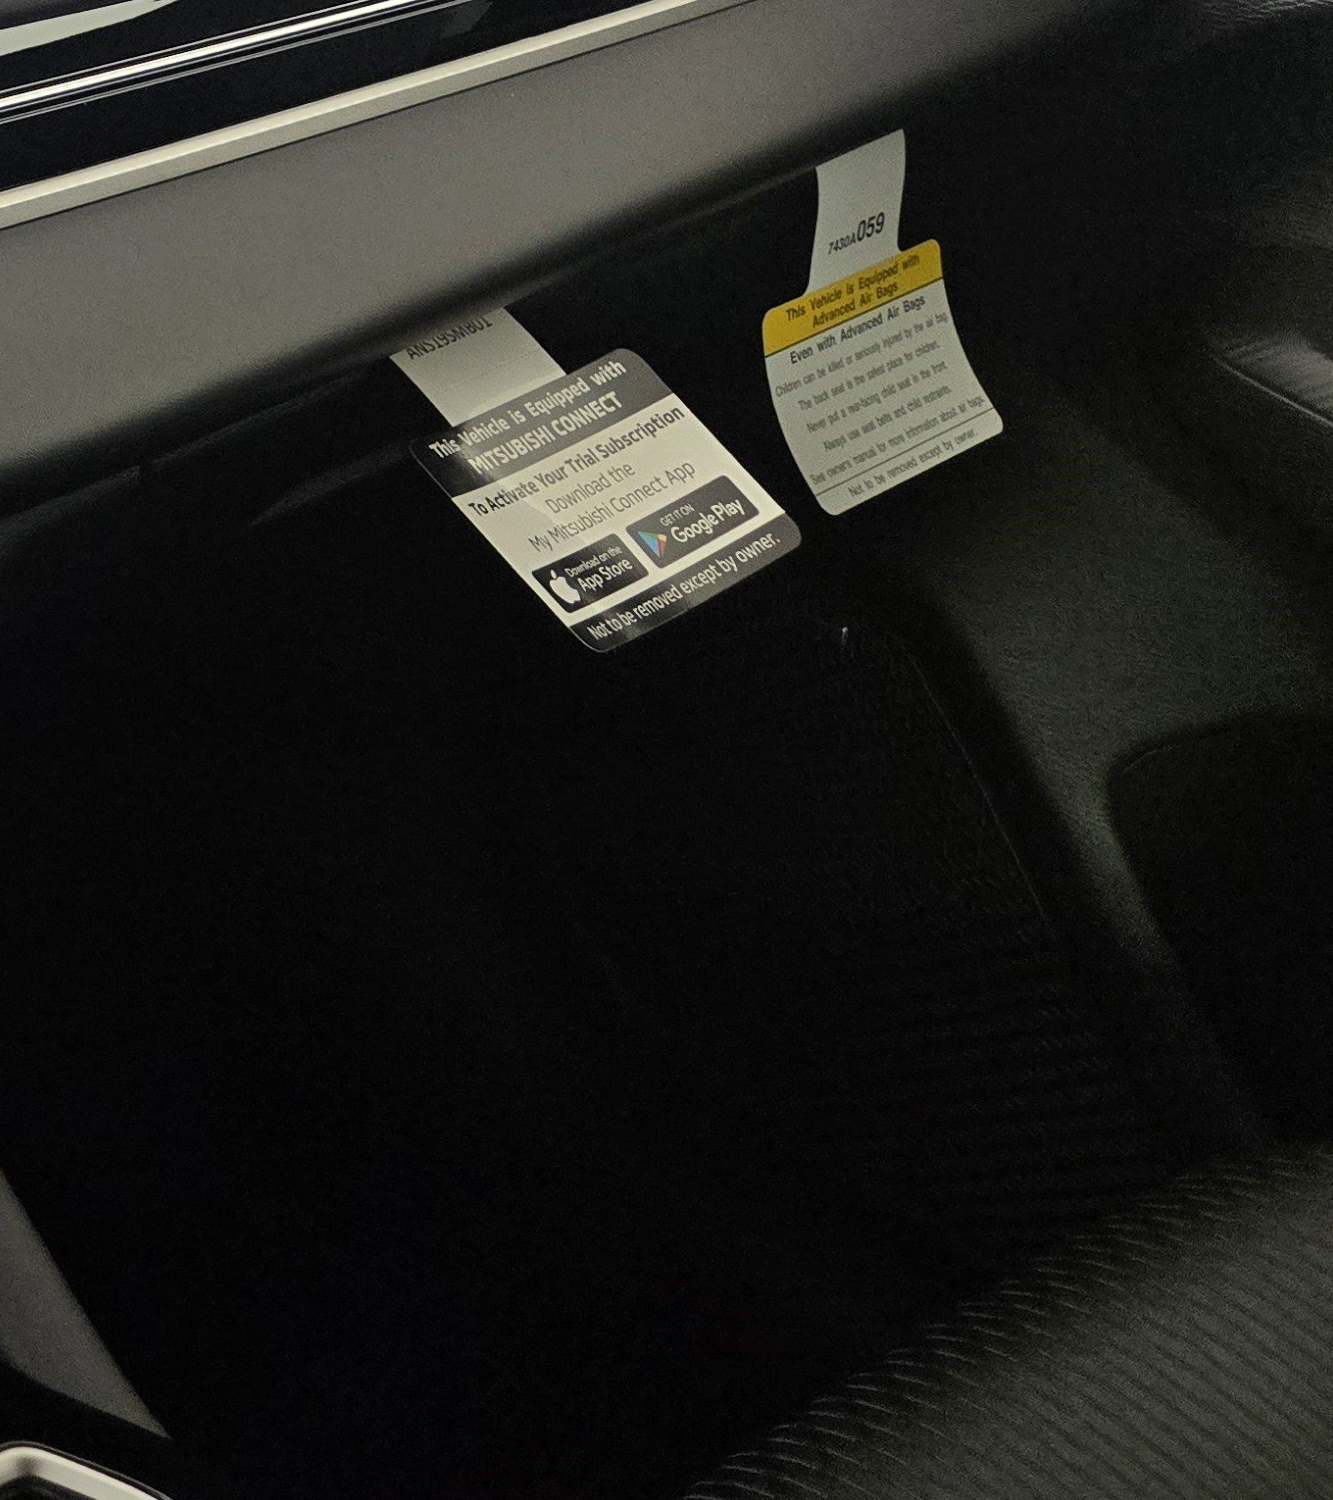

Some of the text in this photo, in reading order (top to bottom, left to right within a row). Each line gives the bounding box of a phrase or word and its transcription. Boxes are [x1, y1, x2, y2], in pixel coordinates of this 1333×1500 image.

[786, 306, 806, 322] This
[811, 289, 842, 310] Vehicle
[859, 263, 899, 292] Equipped
[812, 301, 856, 328] Advanced
[876, 281, 899, 299] Bags
[790, 295, 926, 364] Even with Advanced Air Bags
[429, 359, 628, 459] This Vehicle is Equipped with
[467, 391, 622, 476] MITSUBISHI CONNECT
[468, 405, 686, 517] To Activate Your Trial Subscription
[544, 461, 636, 515] Download the
[528, 460, 697, 554] My Mitsubishi Connect App
[671, 499, 745, 543] Google Play
[577, 559, 633, 592] App Store
[587, 533, 780, 640] Not to be removed except by owner.
